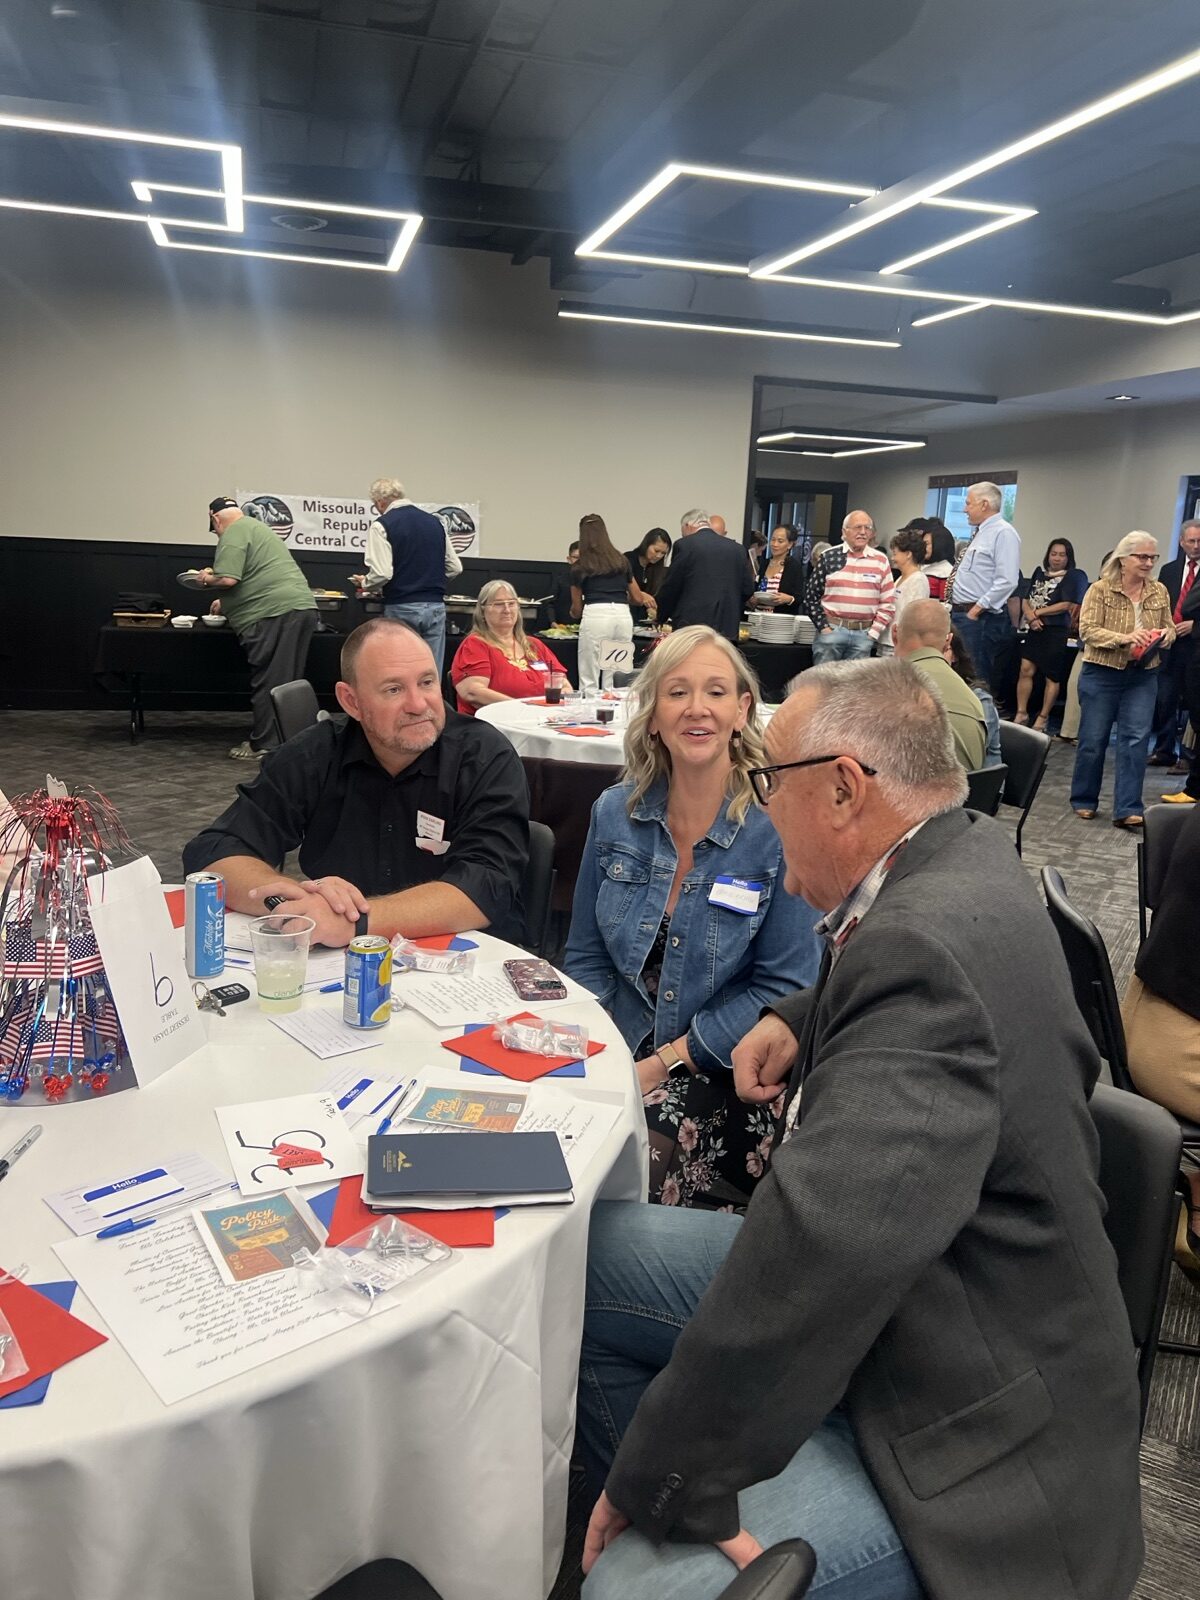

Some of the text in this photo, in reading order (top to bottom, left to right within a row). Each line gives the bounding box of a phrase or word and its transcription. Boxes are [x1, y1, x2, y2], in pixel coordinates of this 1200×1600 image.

[303, 500, 366, 515] Missoula
[323, 518, 372, 533] Republ
[295, 533, 346, 547] Central
[605, 649, 628, 663] 10
[215, 907, 225, 961] ULTRA
[160, 1008, 178, 1024] TABLE
[152, 1014, 190, 1044] DESSERT DASH
[112, 1178, 138, 1191] Hello
[220, 1208, 274, 1231] Policy
